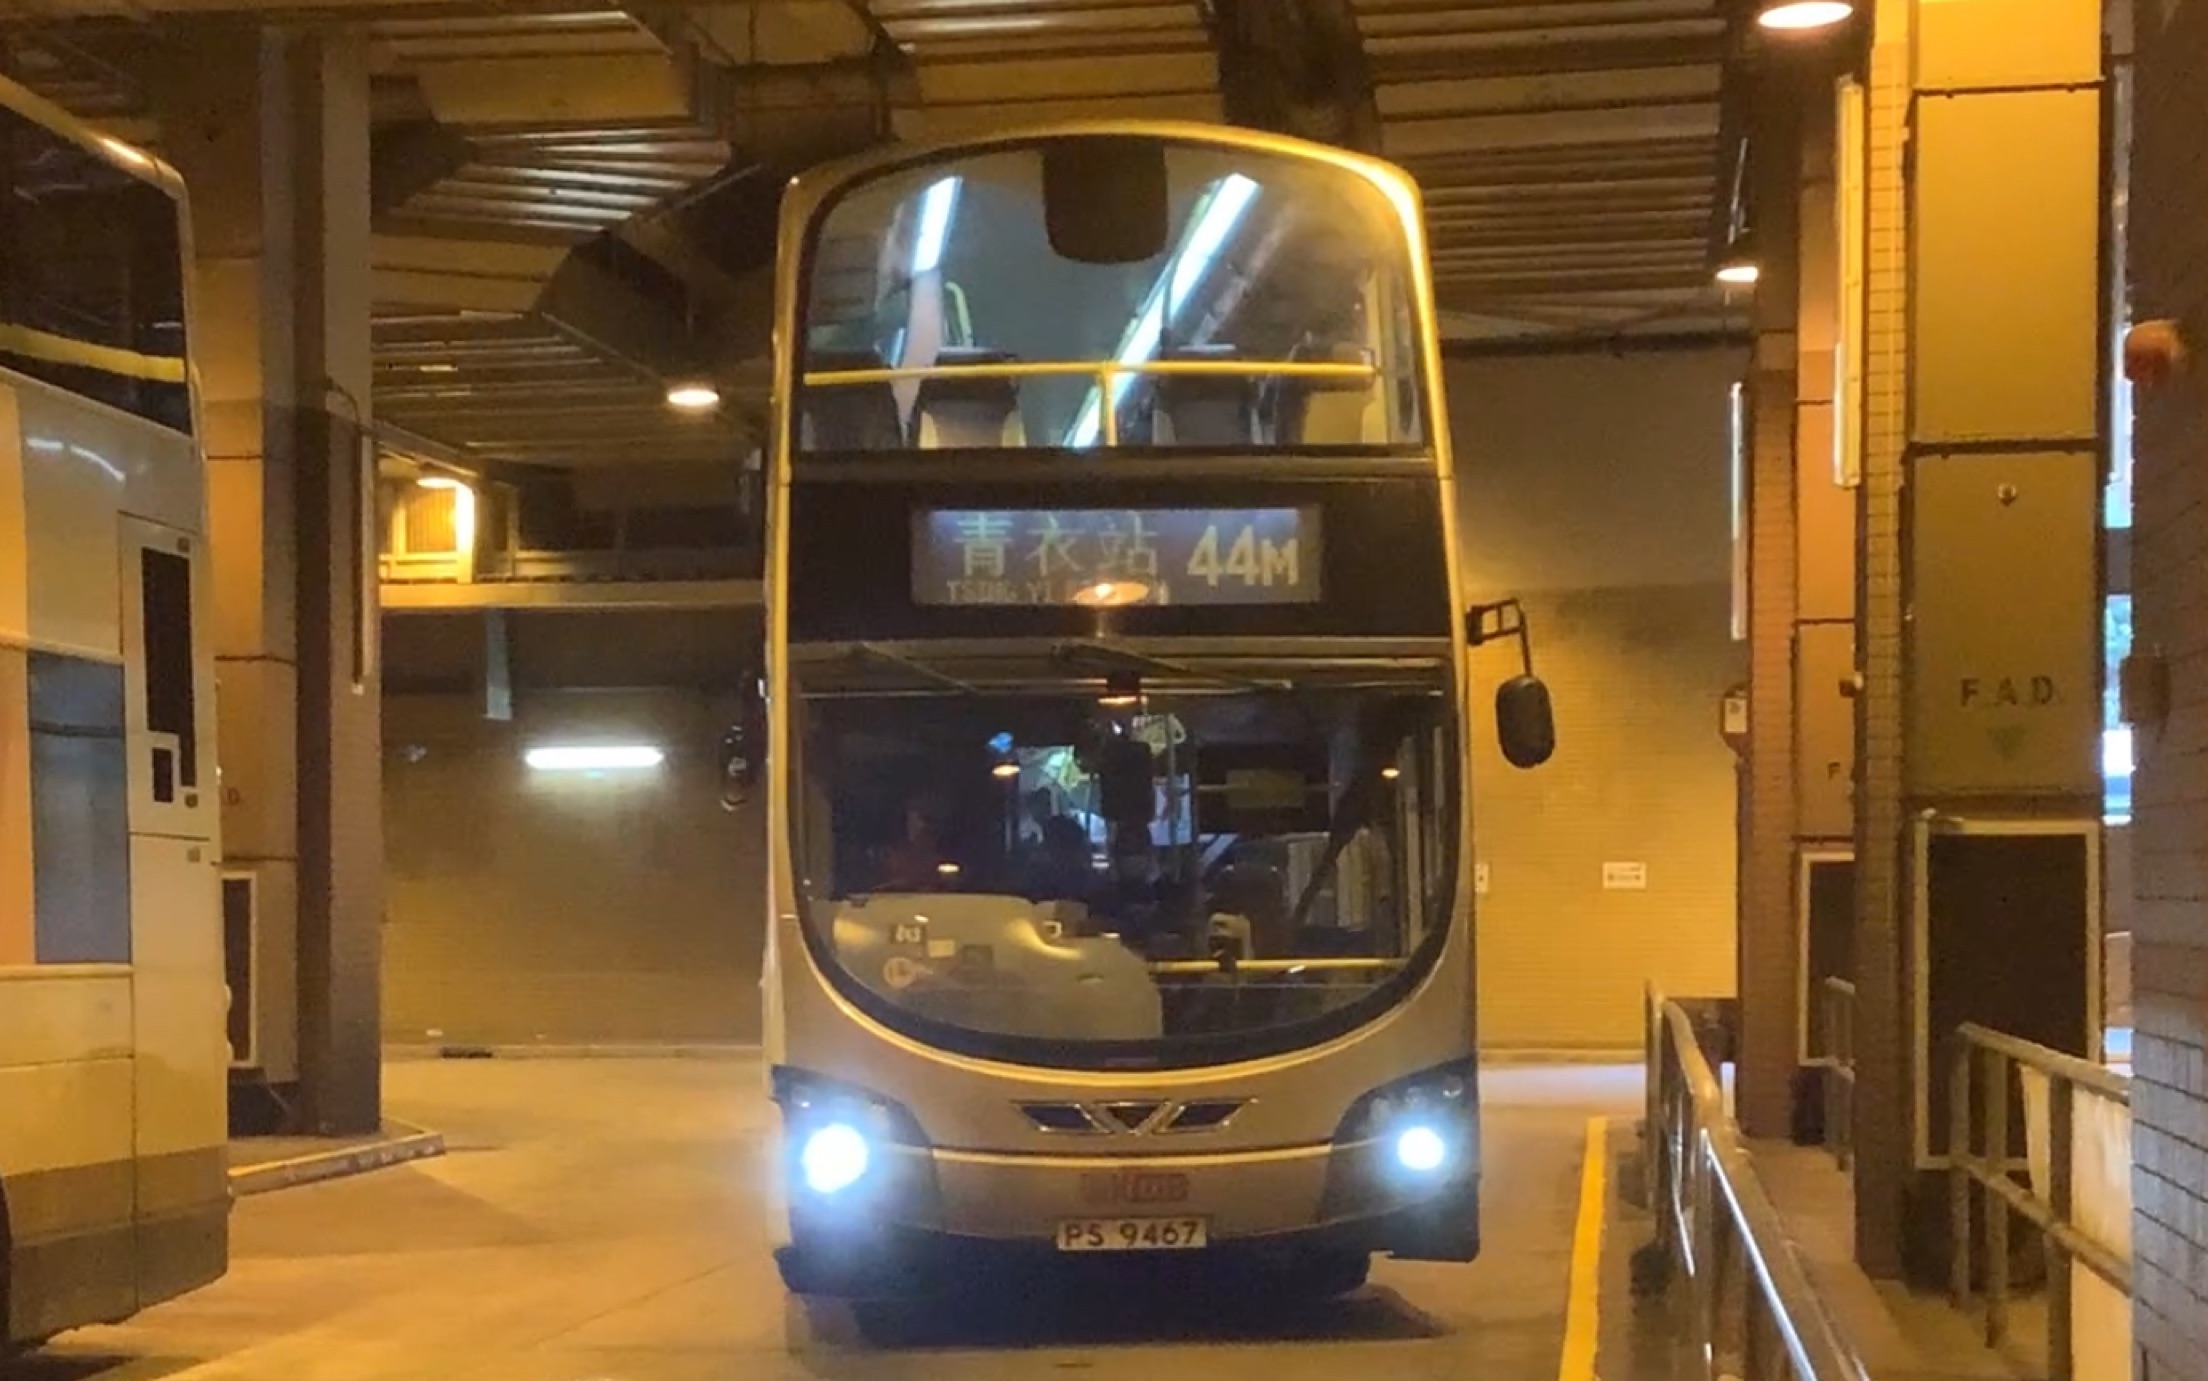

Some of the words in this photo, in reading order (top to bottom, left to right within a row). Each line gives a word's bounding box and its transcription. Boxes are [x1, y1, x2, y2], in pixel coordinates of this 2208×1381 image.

[953, 511, 1159, 577] 青衣站
[1186, 524, 1299, 586] 44M
[1064, 1223, 1104, 1246] PS
[1119, 1221, 1199, 1246] 9467
